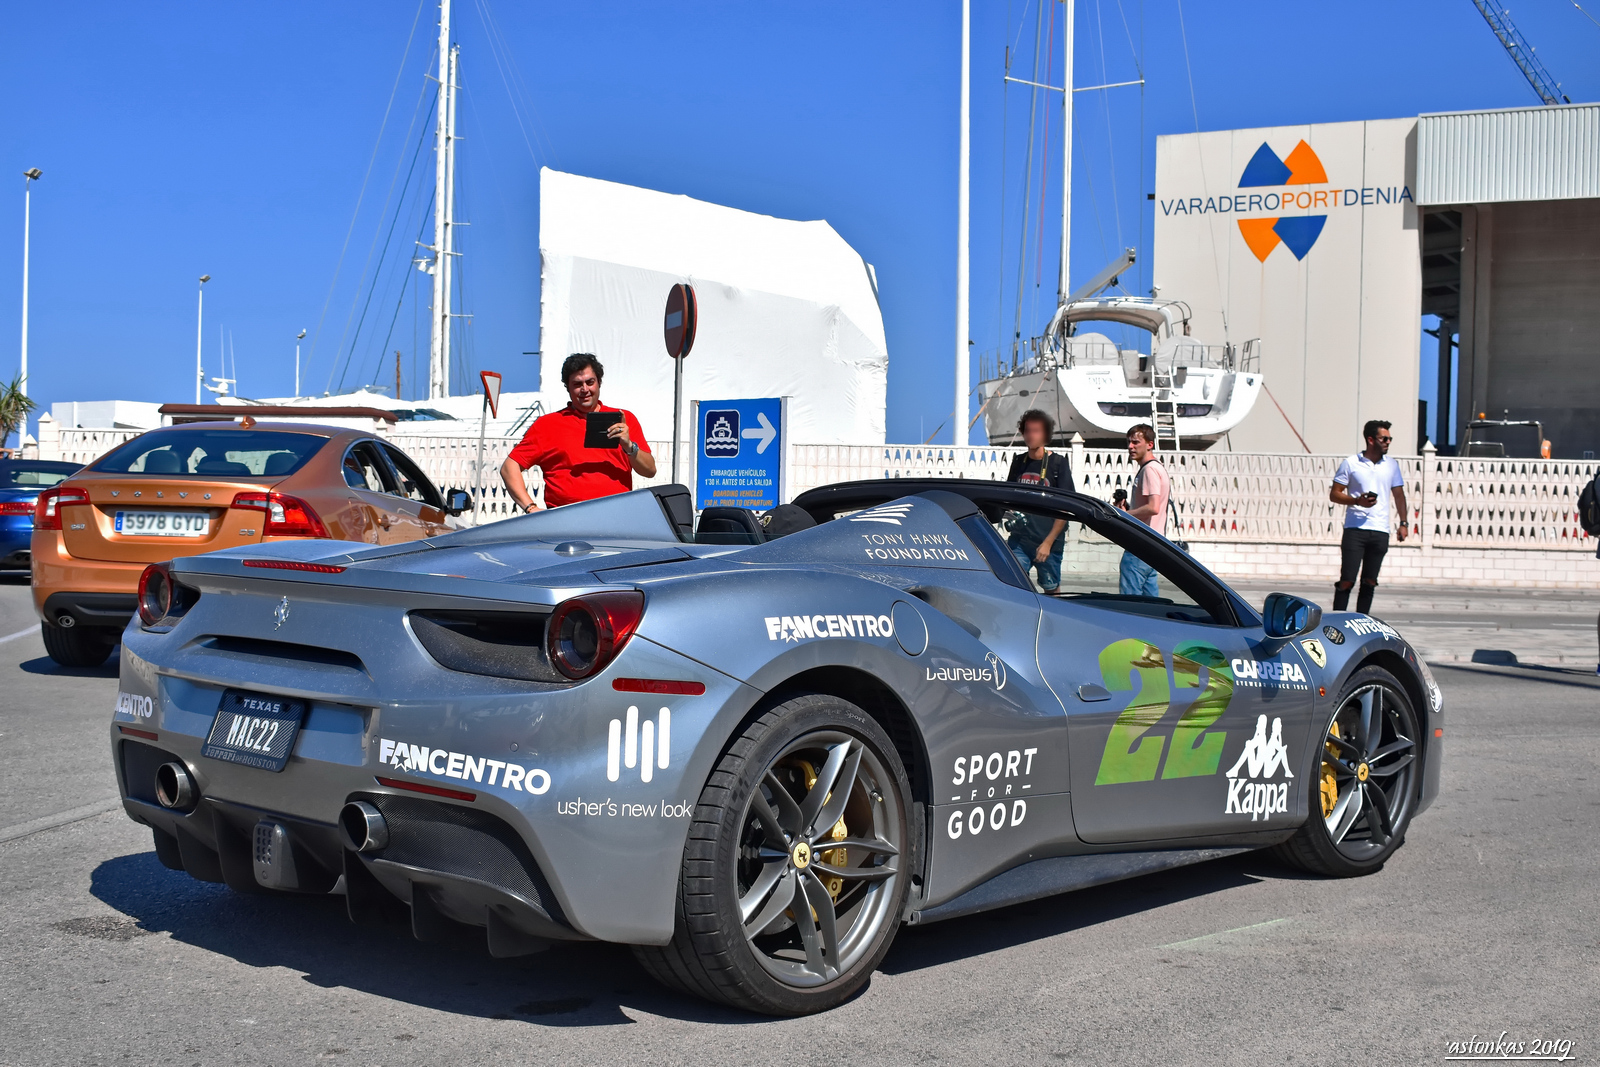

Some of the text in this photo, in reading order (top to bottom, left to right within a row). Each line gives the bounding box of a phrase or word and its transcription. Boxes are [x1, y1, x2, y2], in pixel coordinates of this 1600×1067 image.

[710, 468, 766, 477] EMBARQUE VEHÍCULOS
[111, 490, 212, 500] VOLVO
[125, 513, 166, 530] 5978
[172, 514, 204, 531] GYD
[862, 534, 954, 545] TONY HAWK
[864, 548, 970, 561] FOUNDATION
[764, 614, 893, 644] FANCENTRO
[1231, 658, 1307, 683] CARRERA
[243, 699, 281, 713] TEXAS
[1094, 638, 1235, 786] 22
[226, 714, 279, 752] MAC22
[242, 755, 278, 770] HOUSTON
[379, 738, 552, 796] FANCENTRO
[952, 747, 1038, 786] SPORT
[971, 784, 1012, 801] FOR
[1225, 778, 1289, 822] Kappa
[557, 797, 692, 818] usher's new look
[947, 799, 1028, 840] GOOD
